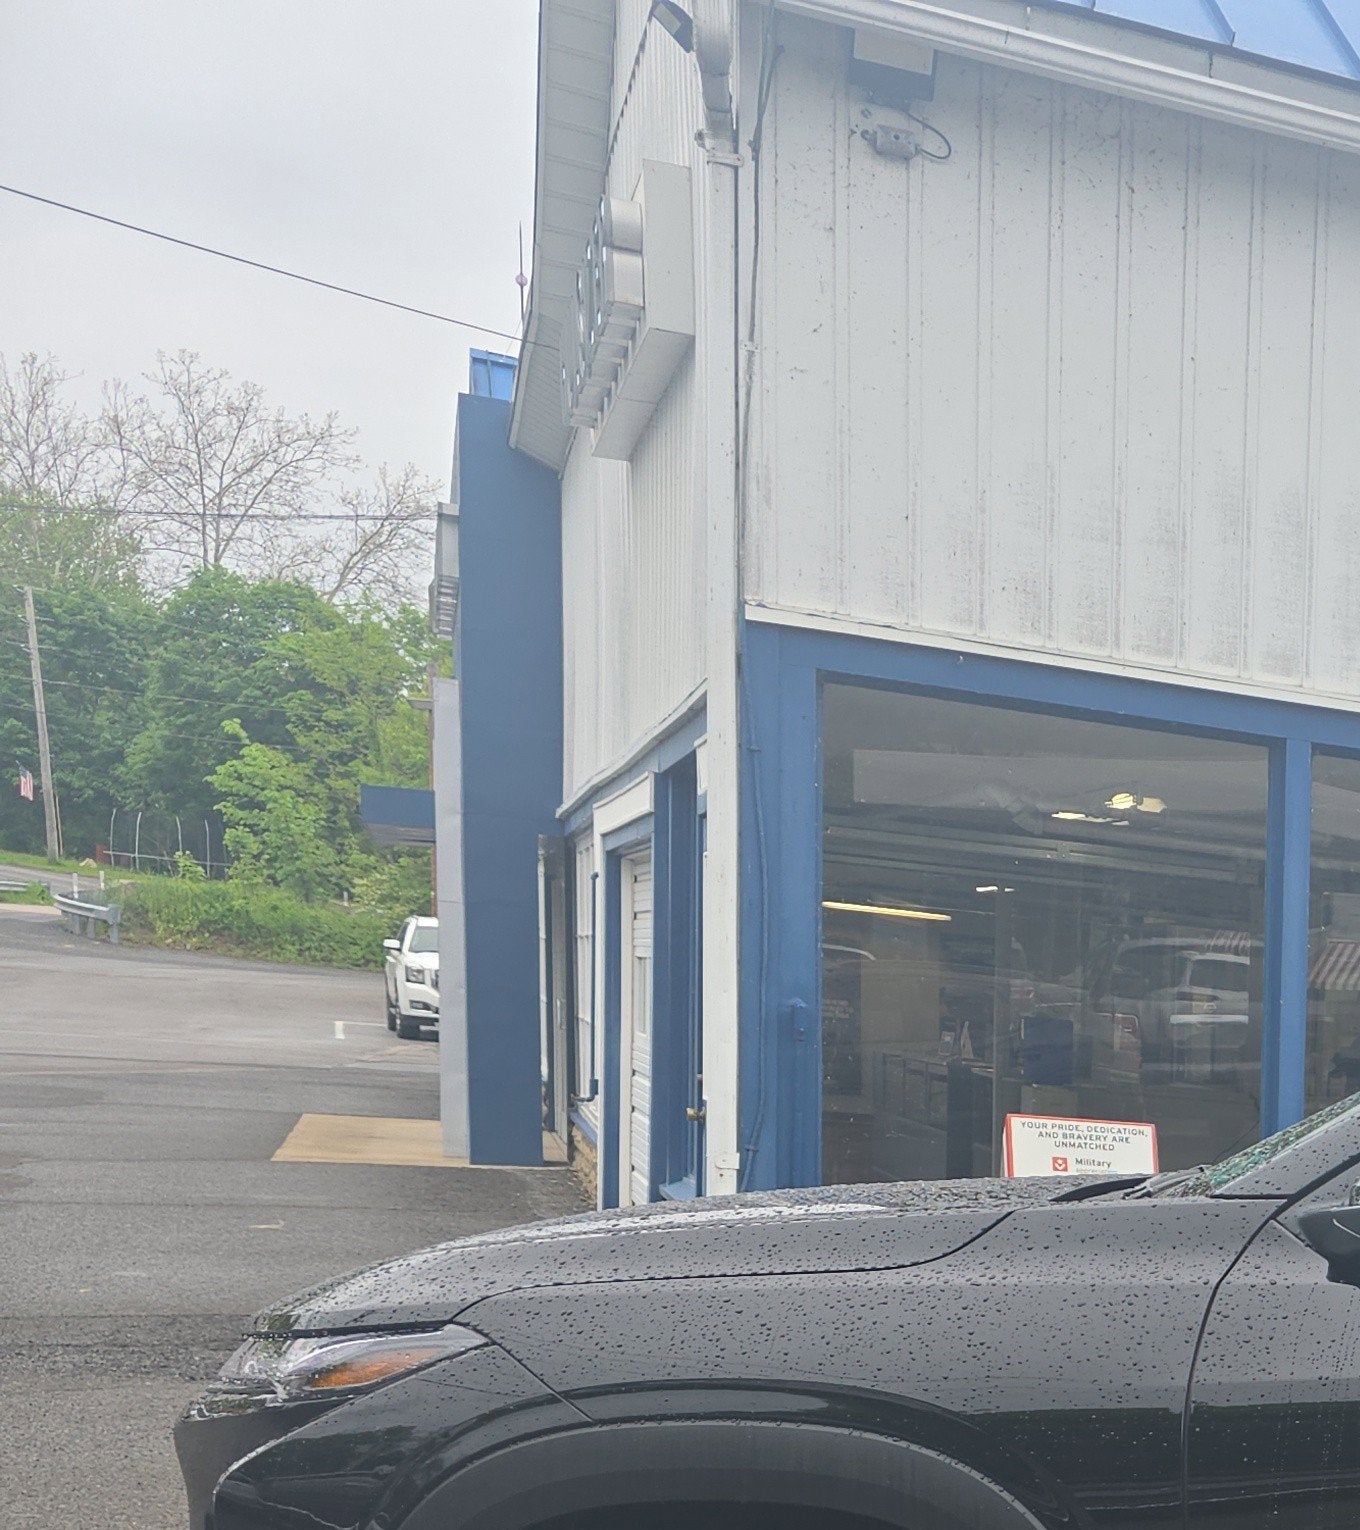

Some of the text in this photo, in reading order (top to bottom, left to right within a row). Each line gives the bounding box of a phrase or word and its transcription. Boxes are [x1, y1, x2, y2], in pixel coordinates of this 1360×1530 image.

[1020, 1121, 1048, 1130] YOUR
[1037, 1131, 1131, 1144] AND BRAVERY ARE
[1054, 1141, 1115, 1151] UNMATCHED
[1075, 1157, 1112, 1169] Military
